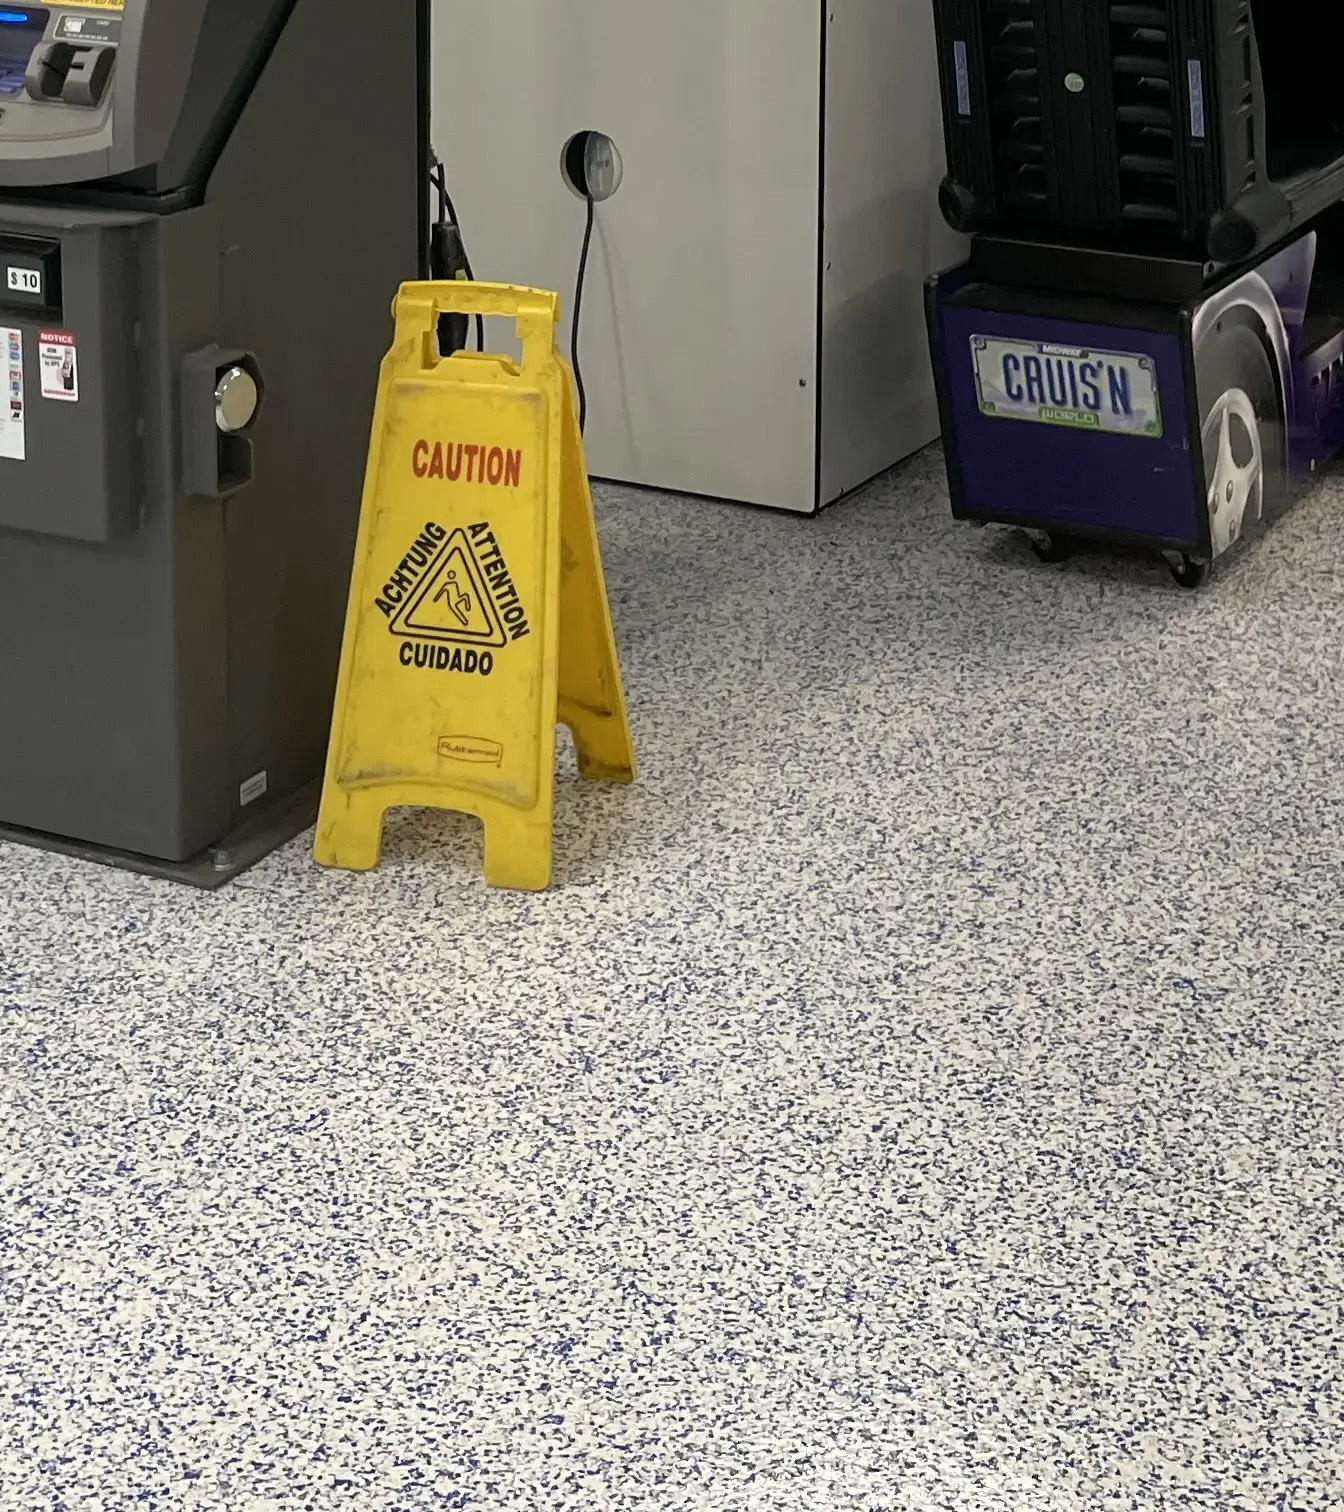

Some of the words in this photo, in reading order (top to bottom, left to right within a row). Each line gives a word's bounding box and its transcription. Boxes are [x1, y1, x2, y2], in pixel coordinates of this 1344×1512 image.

[10, 271, 18, 286] $
[22, 273, 38, 288] 10
[40, 331, 74, 345] NOTICE
[1002, 352, 1131, 416] CRUIS'N
[412, 438, 522, 488] CAUTION
[374, 520, 448, 620] ACHTUNG
[466, 520, 531, 640] ATTENTION
[398, 641, 494, 677] CUIDADO
